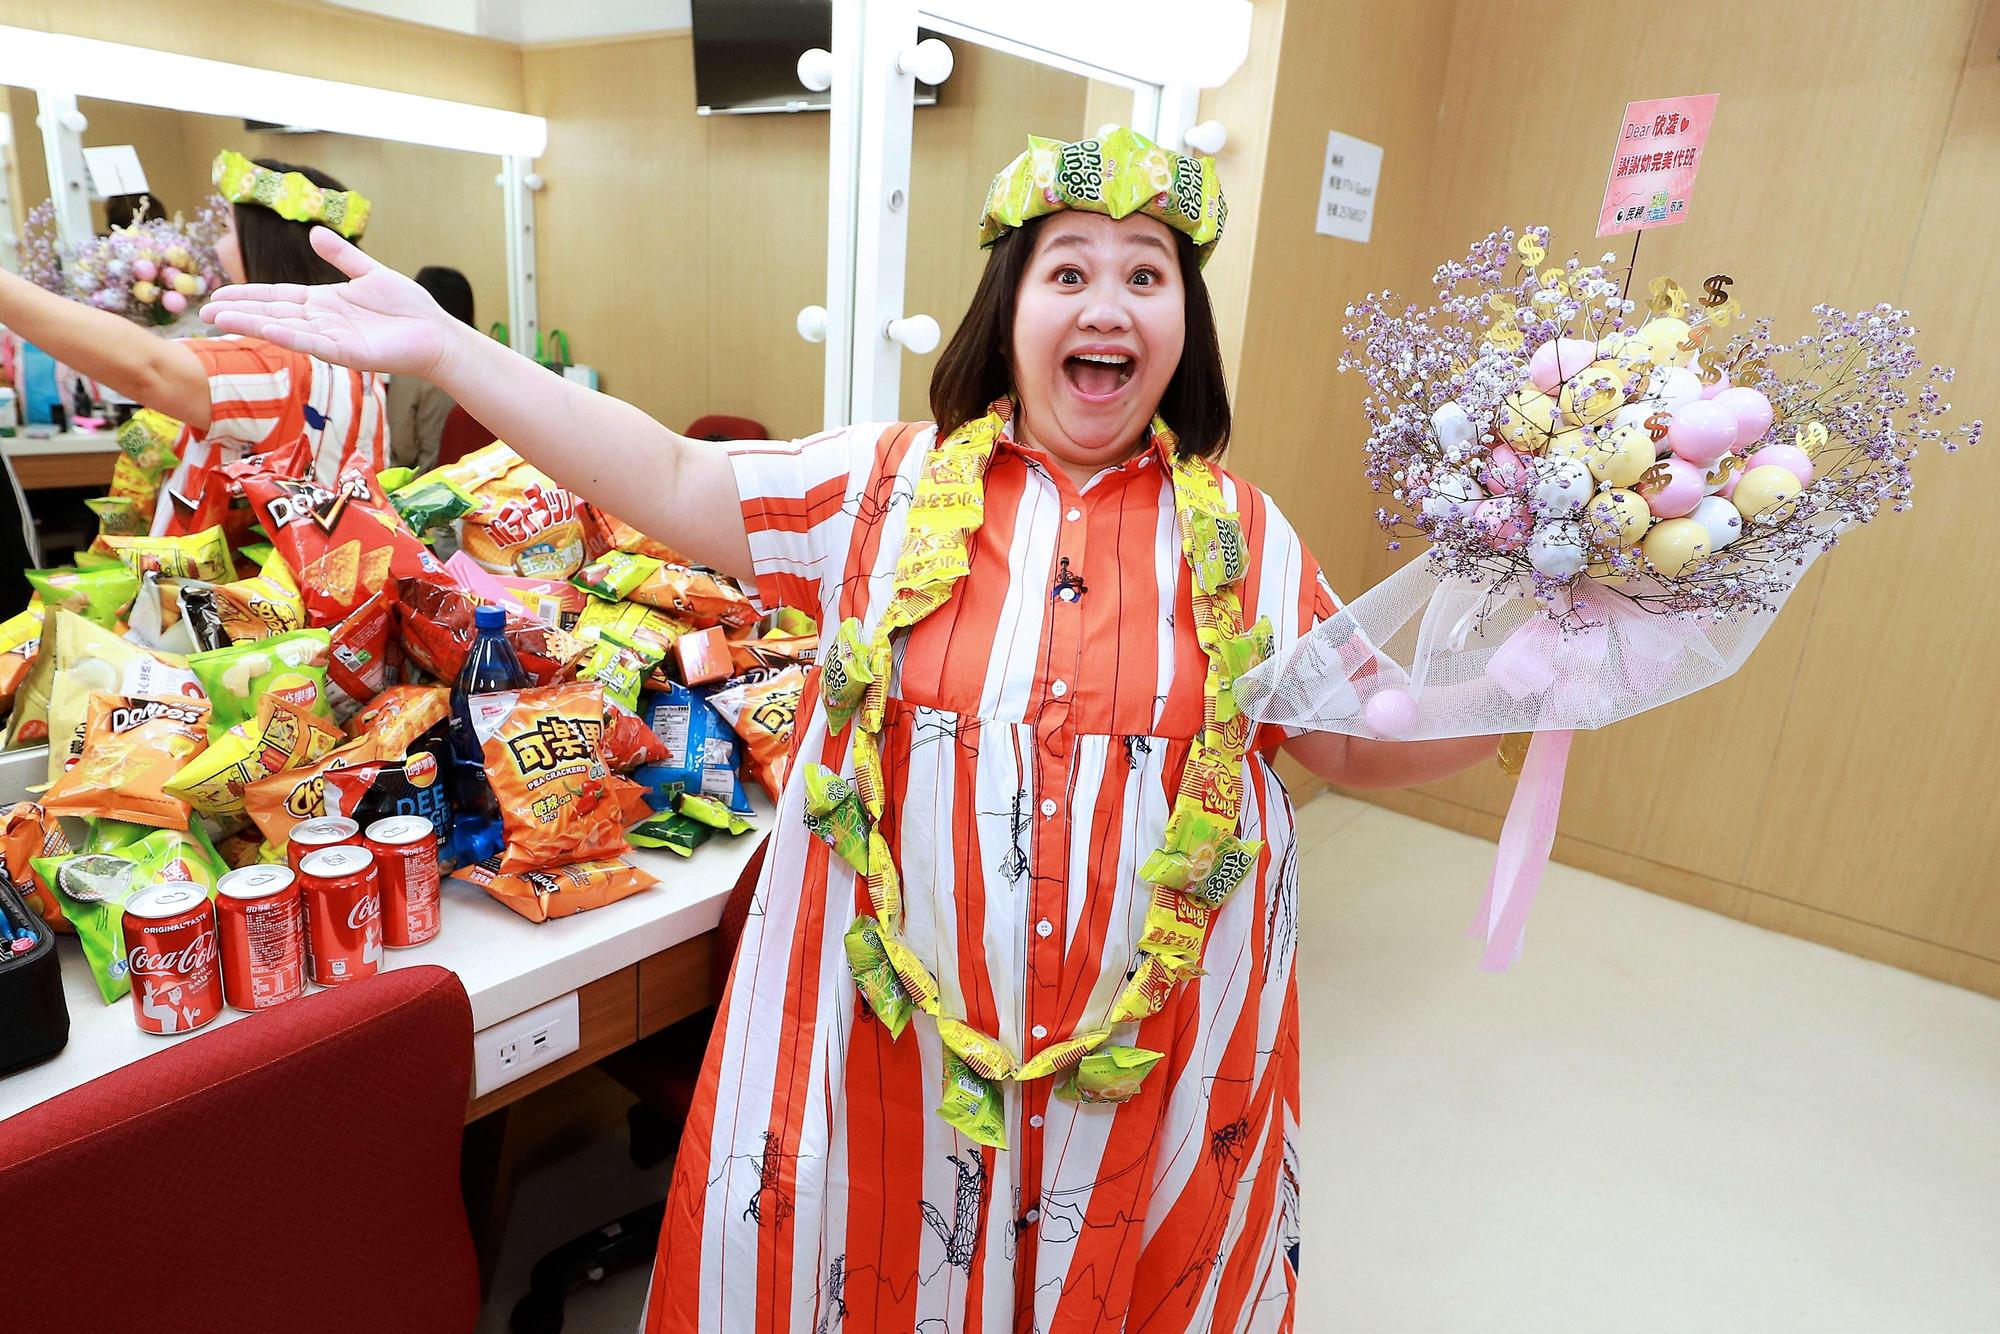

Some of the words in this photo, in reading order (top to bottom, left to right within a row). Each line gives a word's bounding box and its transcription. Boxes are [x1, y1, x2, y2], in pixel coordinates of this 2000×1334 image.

[1625, 124, 1651, 139] Dear
[1060, 144, 1085, 200] rings
[1081, 140, 1103, 201] Onion
[1176, 157, 1194, 215] rings
[266, 468, 371, 529] Doros
[112, 702, 201, 734] Doritos
[528, 778, 545, 790] PEA
[545, 765, 587, 781] CRACKERS
[397, 785, 446, 817] DEE
[540, 811, 559, 824] SPICY
[143, 922, 185, 934] ORIGINAL
[184, 912, 208, 927] TASTE
